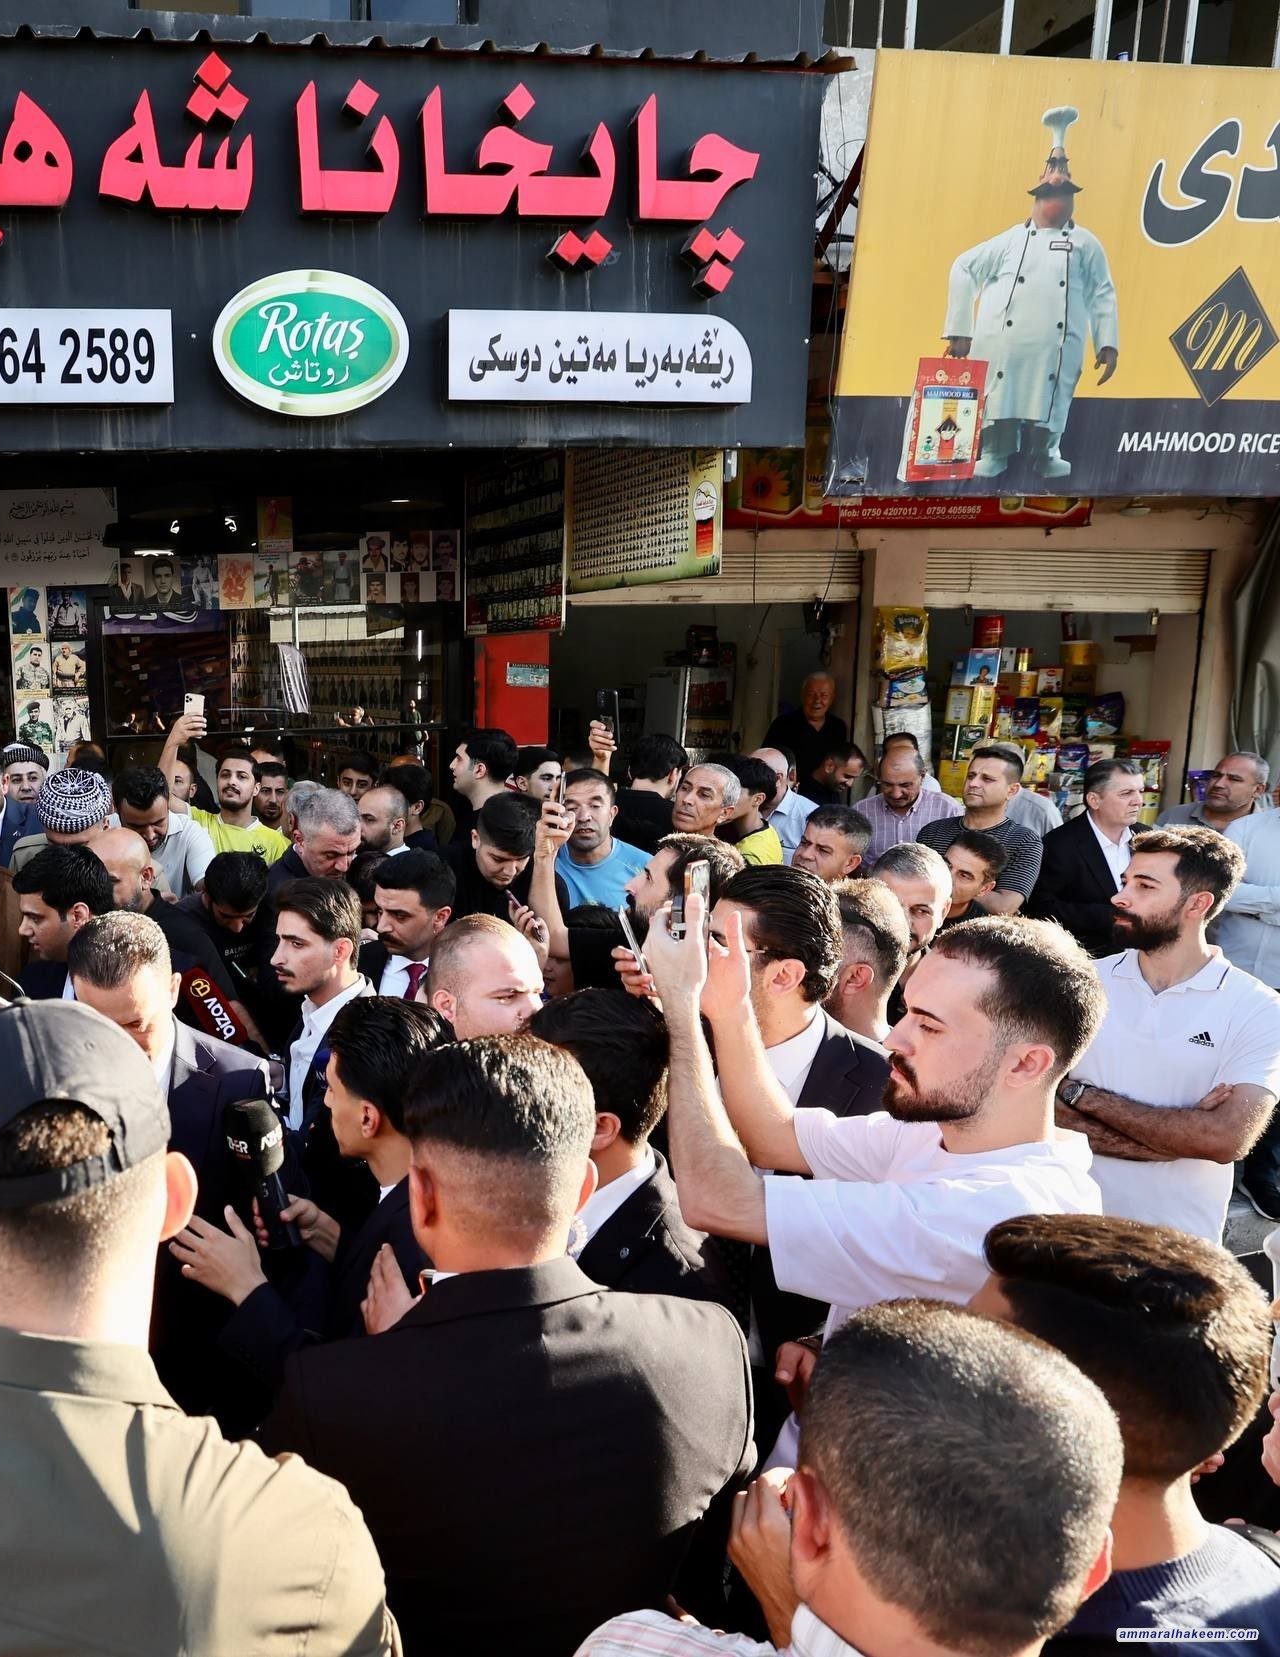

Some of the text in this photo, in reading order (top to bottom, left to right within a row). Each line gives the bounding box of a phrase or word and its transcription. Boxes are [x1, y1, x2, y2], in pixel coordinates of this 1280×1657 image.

[296, 78, 760, 297] چایخانا
[59, 327, 155, 385] 2589
[268, 358, 350, 388] روتاش
[1118, 432, 1280, 454] MAHMOOD RICE
[861, 508, 881, 517] 0750
[926, 506, 945, 515] 0750
[203, 997, 237, 1040] bizav
[1188, 1037, 1215, 1048] adidas
